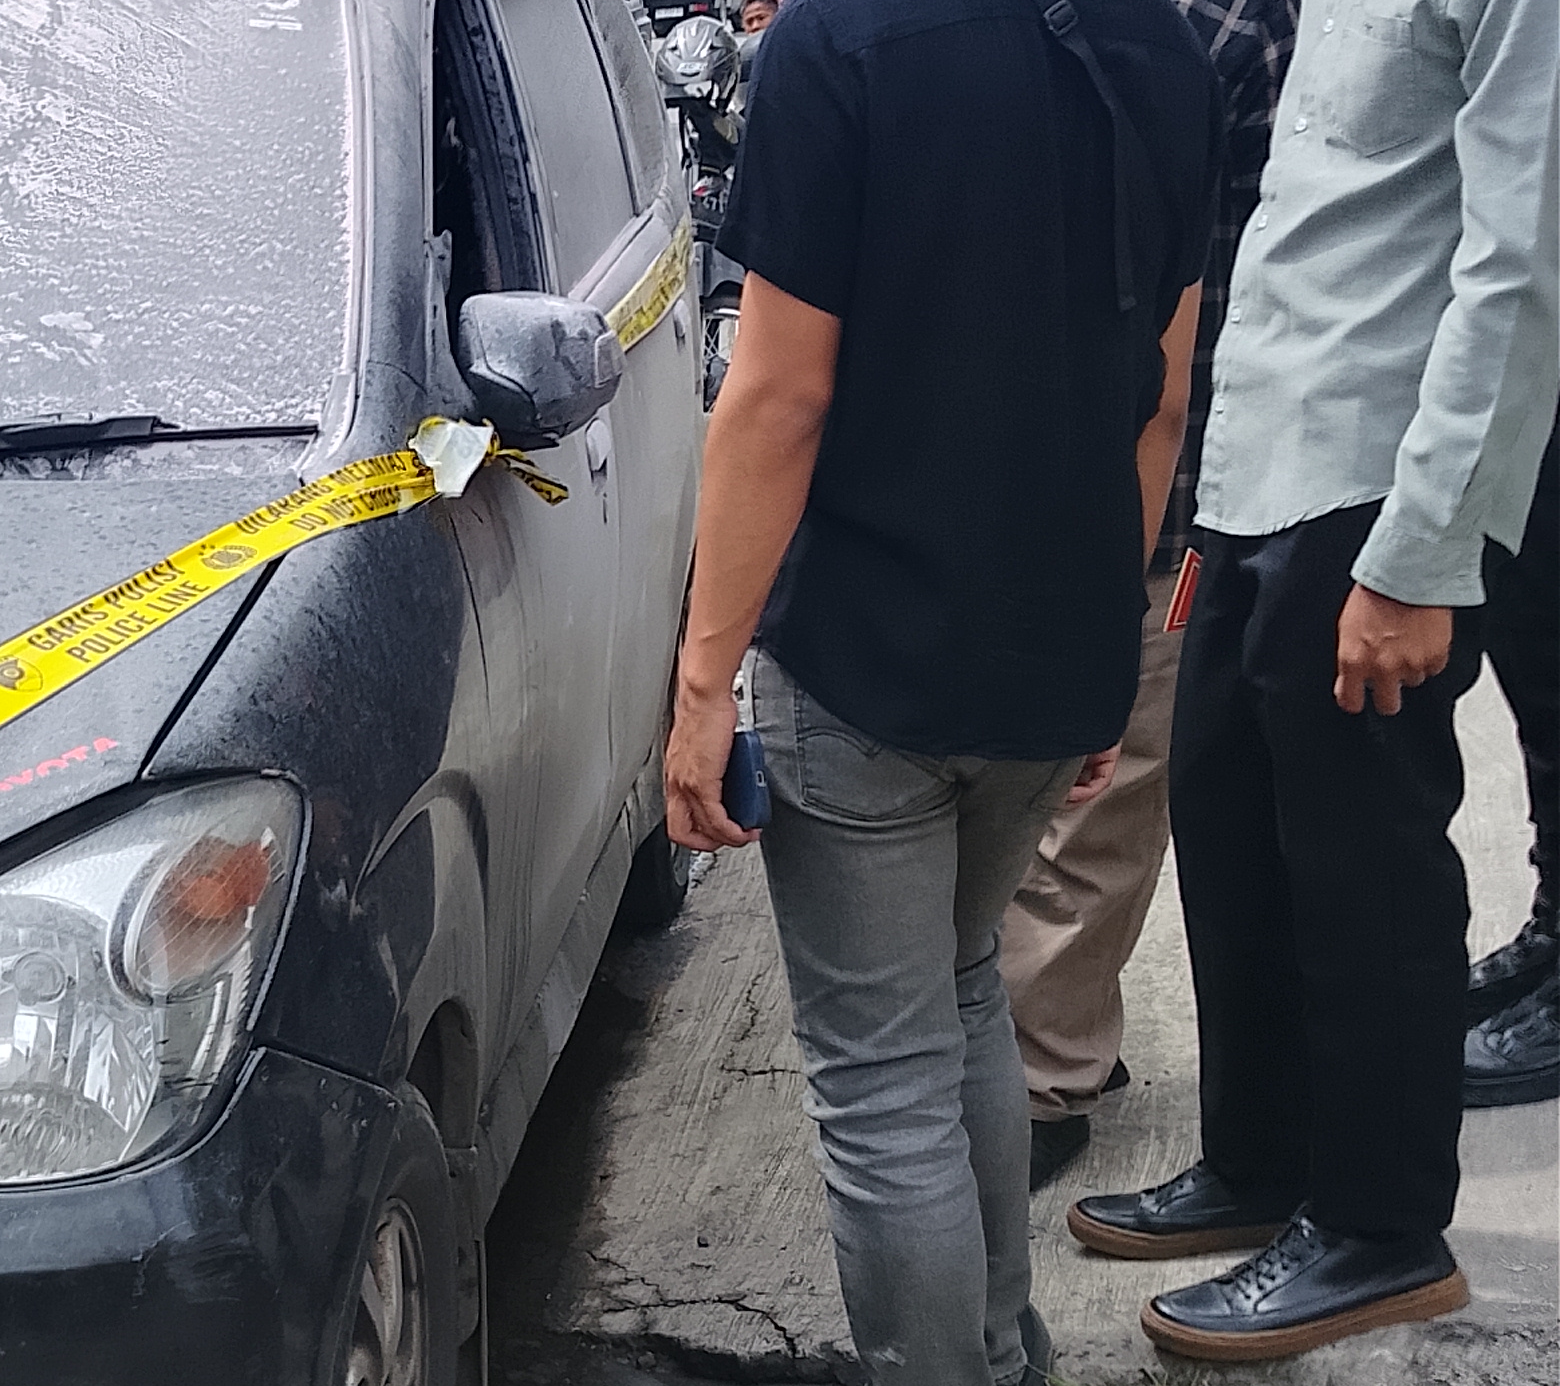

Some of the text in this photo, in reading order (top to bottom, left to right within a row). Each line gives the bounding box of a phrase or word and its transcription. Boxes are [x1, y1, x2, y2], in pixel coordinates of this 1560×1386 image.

[290, 511, 329, 531] DO
[321, 494, 362, 518] NOT
[27, 559, 185, 650] GARIS POLISI
[65, 580, 210, 663] POLICE LINE
